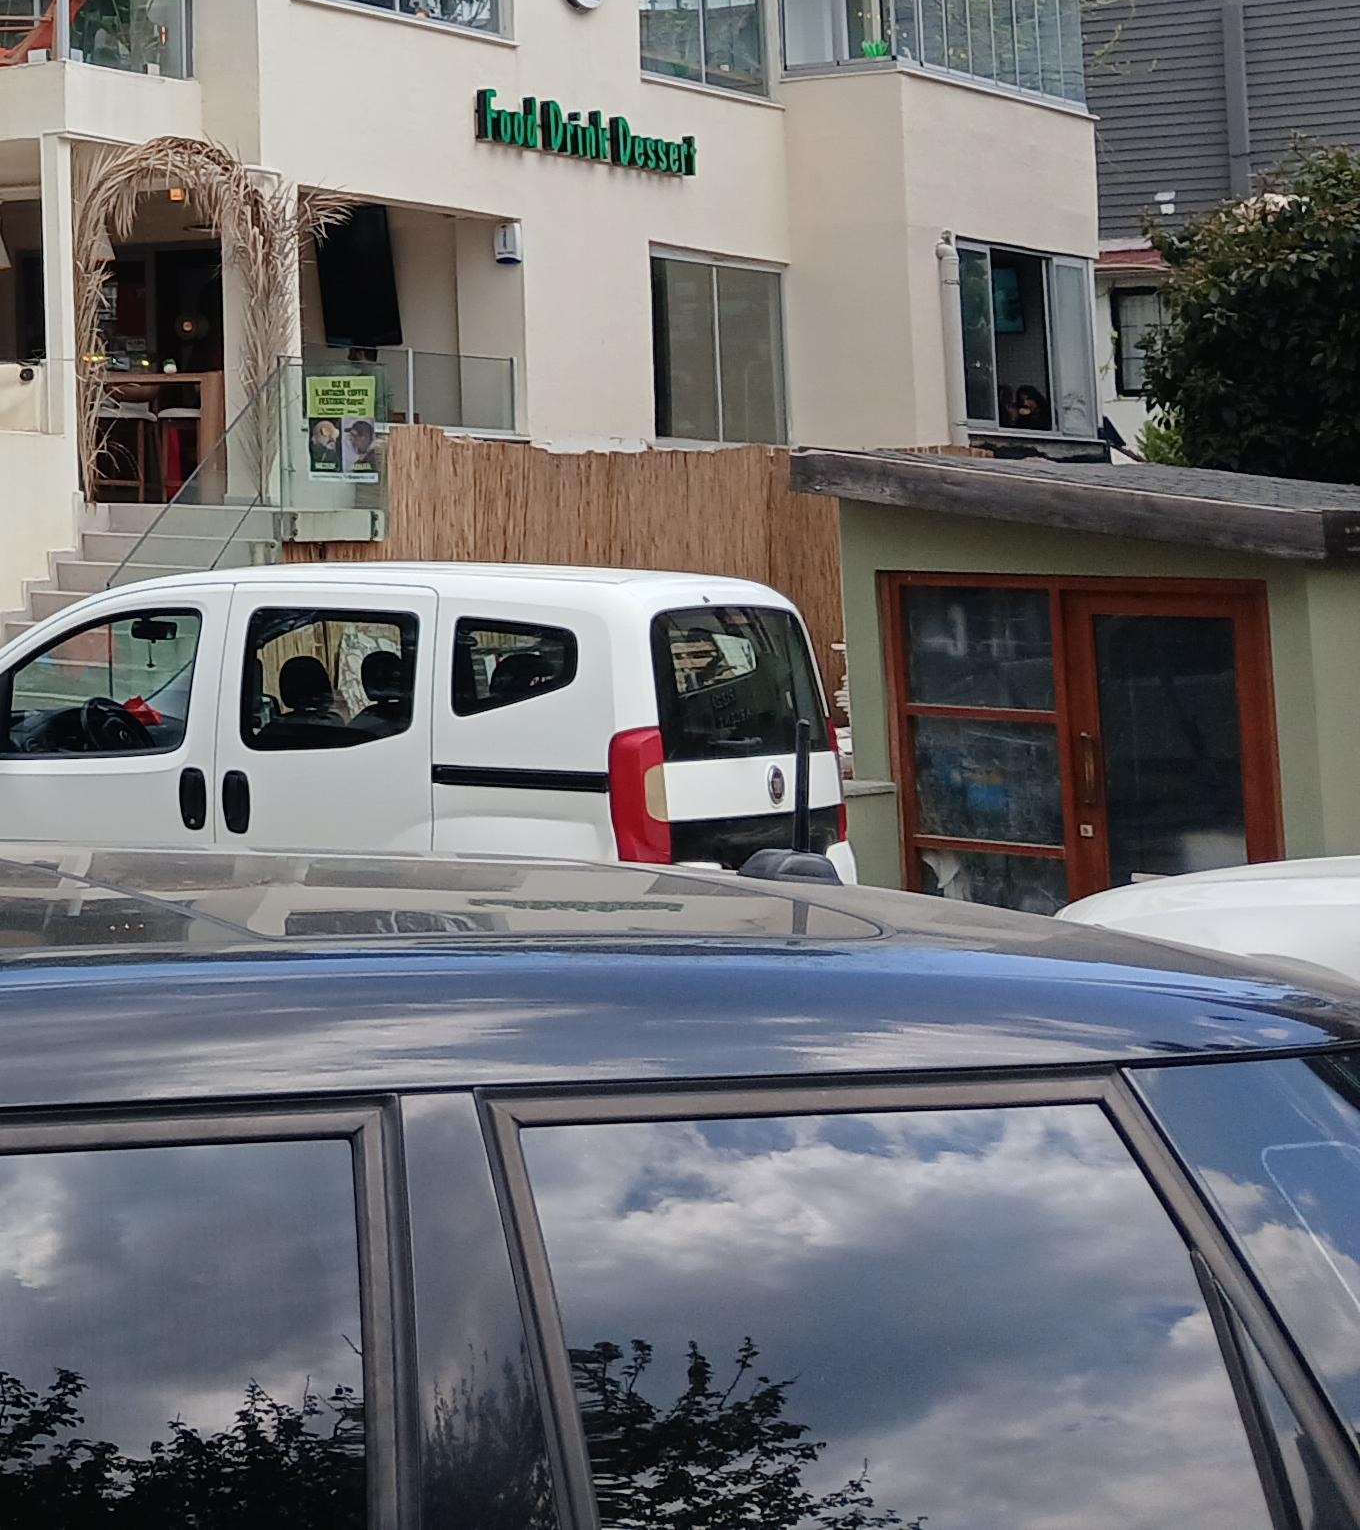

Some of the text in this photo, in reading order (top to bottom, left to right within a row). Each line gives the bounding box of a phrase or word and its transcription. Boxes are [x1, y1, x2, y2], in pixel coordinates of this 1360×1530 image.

[475, 88, 697, 176] Food Drink Dessert
